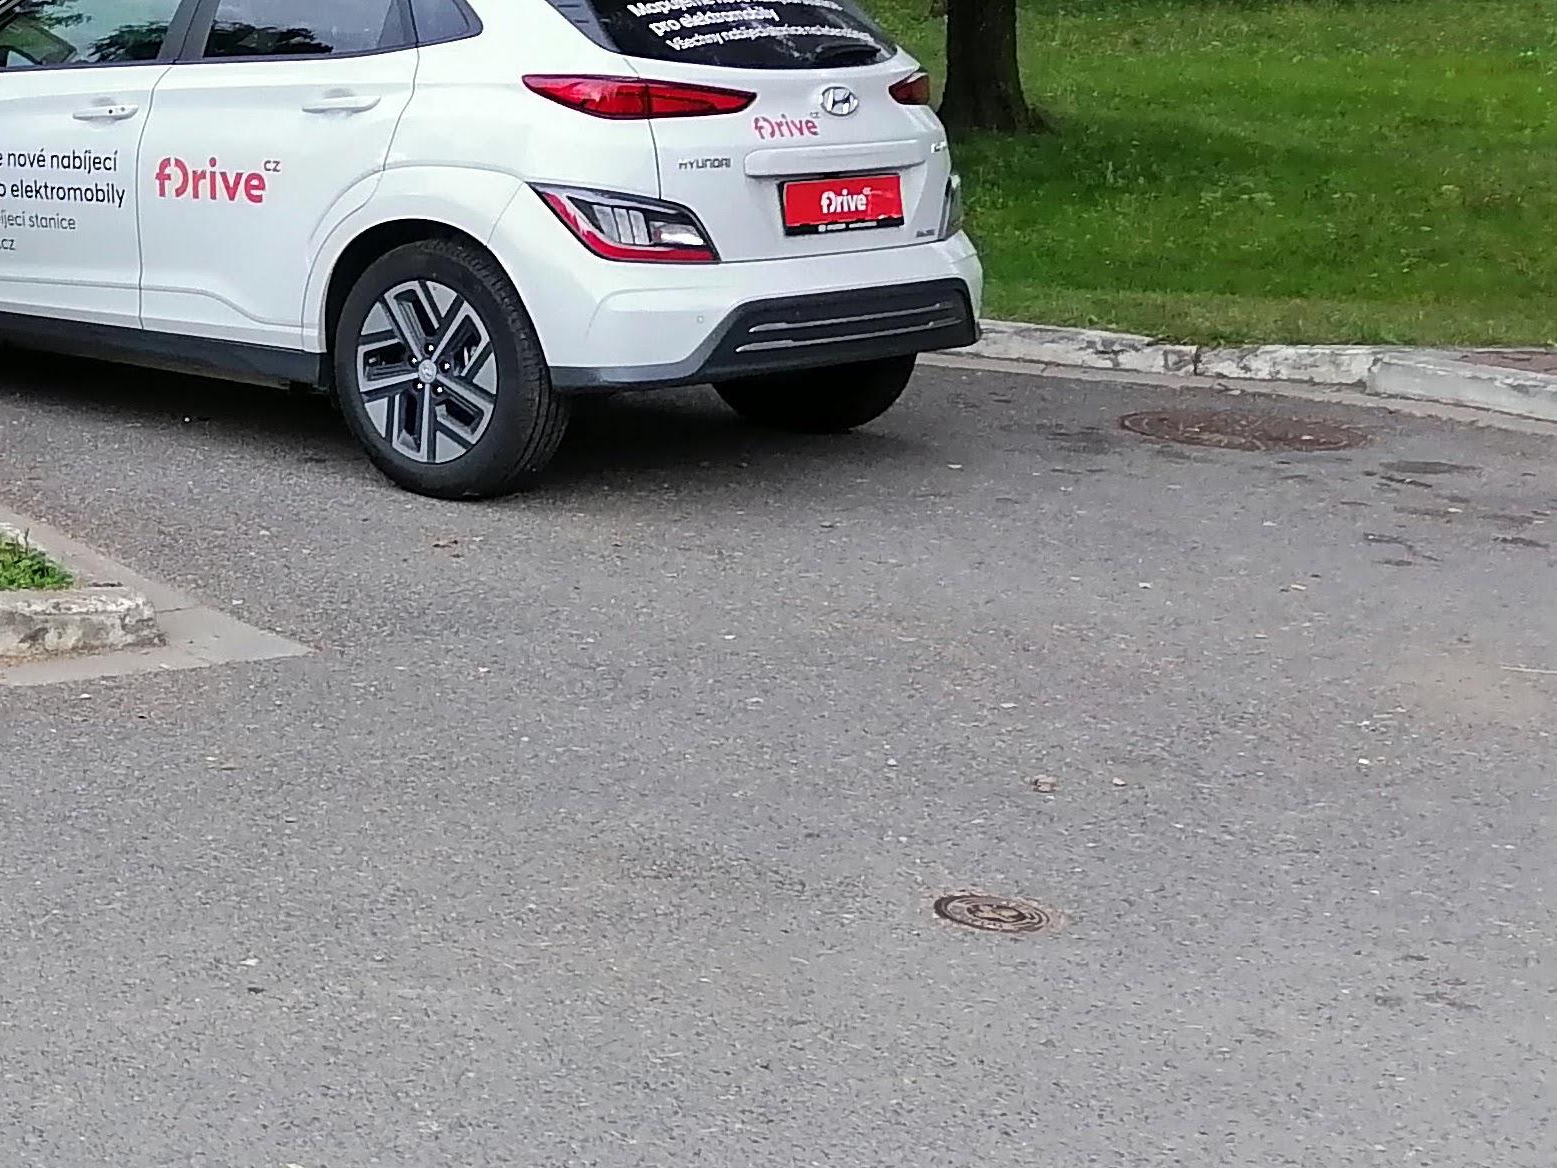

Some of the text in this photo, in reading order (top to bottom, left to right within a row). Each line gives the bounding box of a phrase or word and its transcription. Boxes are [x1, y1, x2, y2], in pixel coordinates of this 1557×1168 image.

[7, 148, 46, 168] nové
[50, 149, 118, 174] nabíjecí
[678, 157, 731, 170] HYUNDAI
[10, 179, 126, 208] elektromobily
[28, 213, 77, 230] stanice
